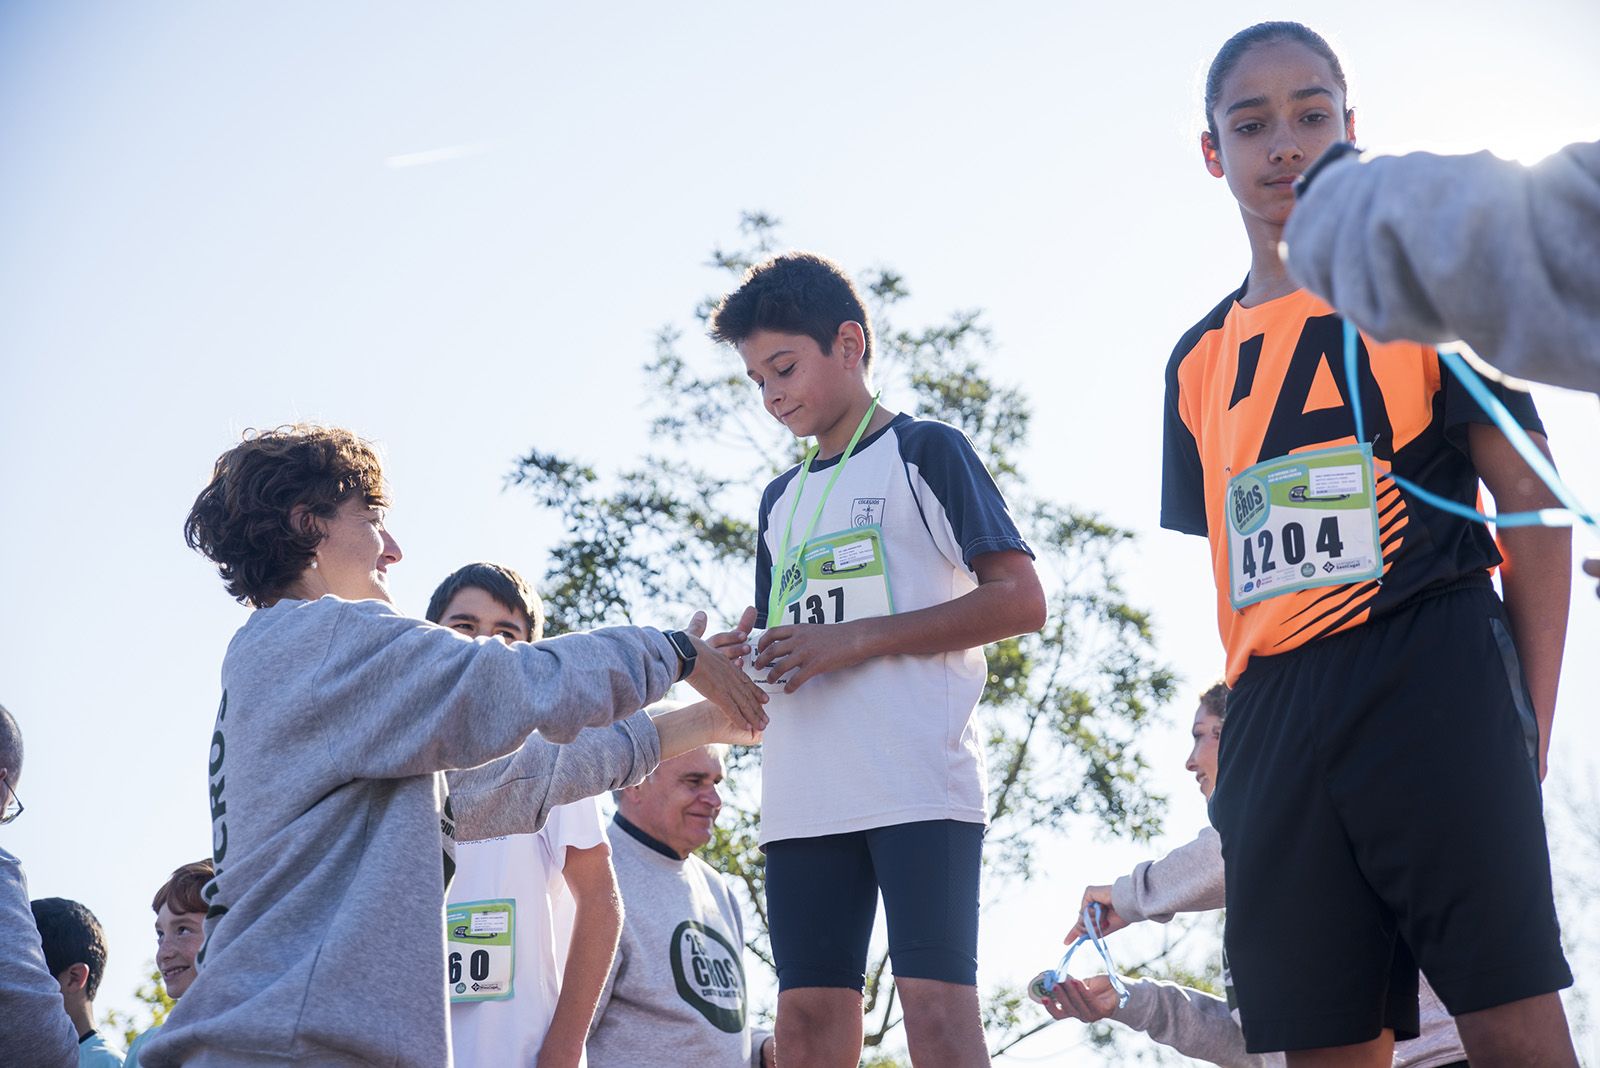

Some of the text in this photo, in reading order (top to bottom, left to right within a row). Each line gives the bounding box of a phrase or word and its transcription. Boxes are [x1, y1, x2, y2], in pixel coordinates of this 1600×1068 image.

[1235, 484, 1263, 524] CROS
[1242, 515, 1344, 579] 4204
[788, 586, 844, 625] 737
[691, 956, 738, 989] CROS
